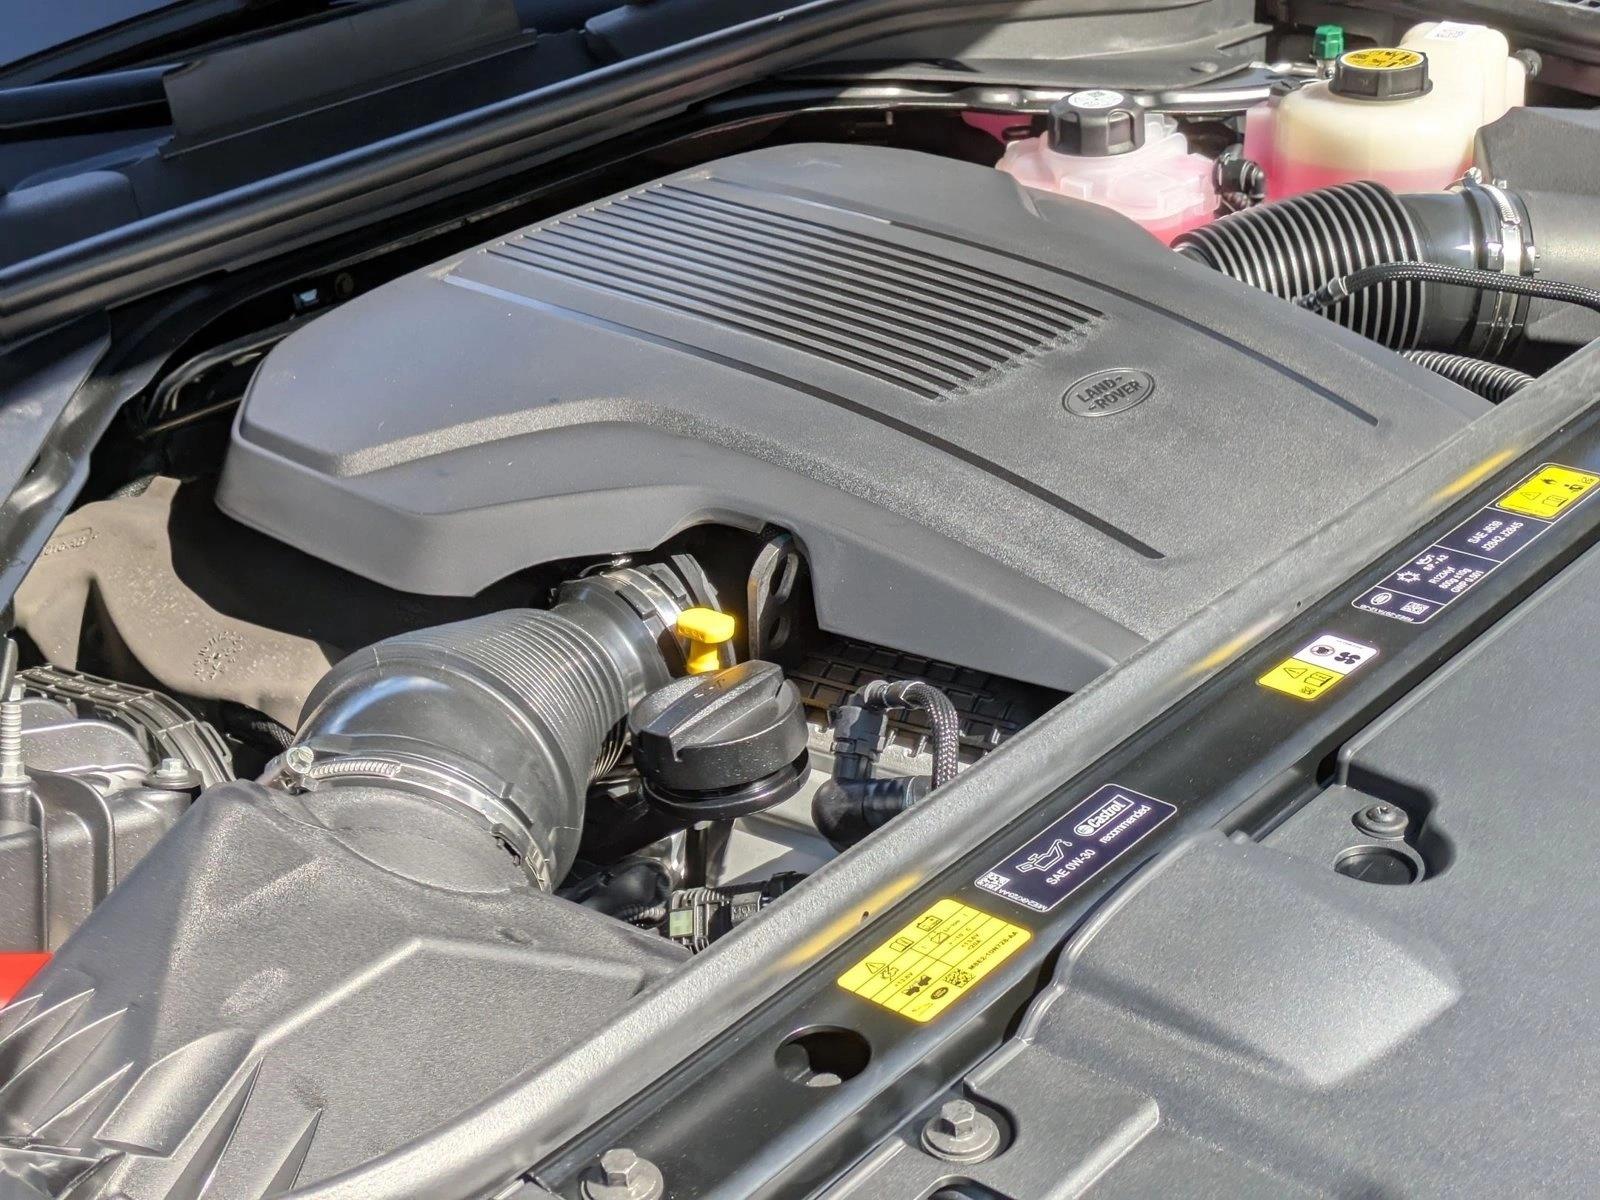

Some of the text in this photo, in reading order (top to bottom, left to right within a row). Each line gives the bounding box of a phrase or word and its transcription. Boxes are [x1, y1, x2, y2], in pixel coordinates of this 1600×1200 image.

[1467, 531, 1488, 543] SAE
[1087, 799, 1126, 829] Castrol
[1099, 804, 1152, 844] recommended
[1046, 849, 1096, 885] SAE 0W-30
